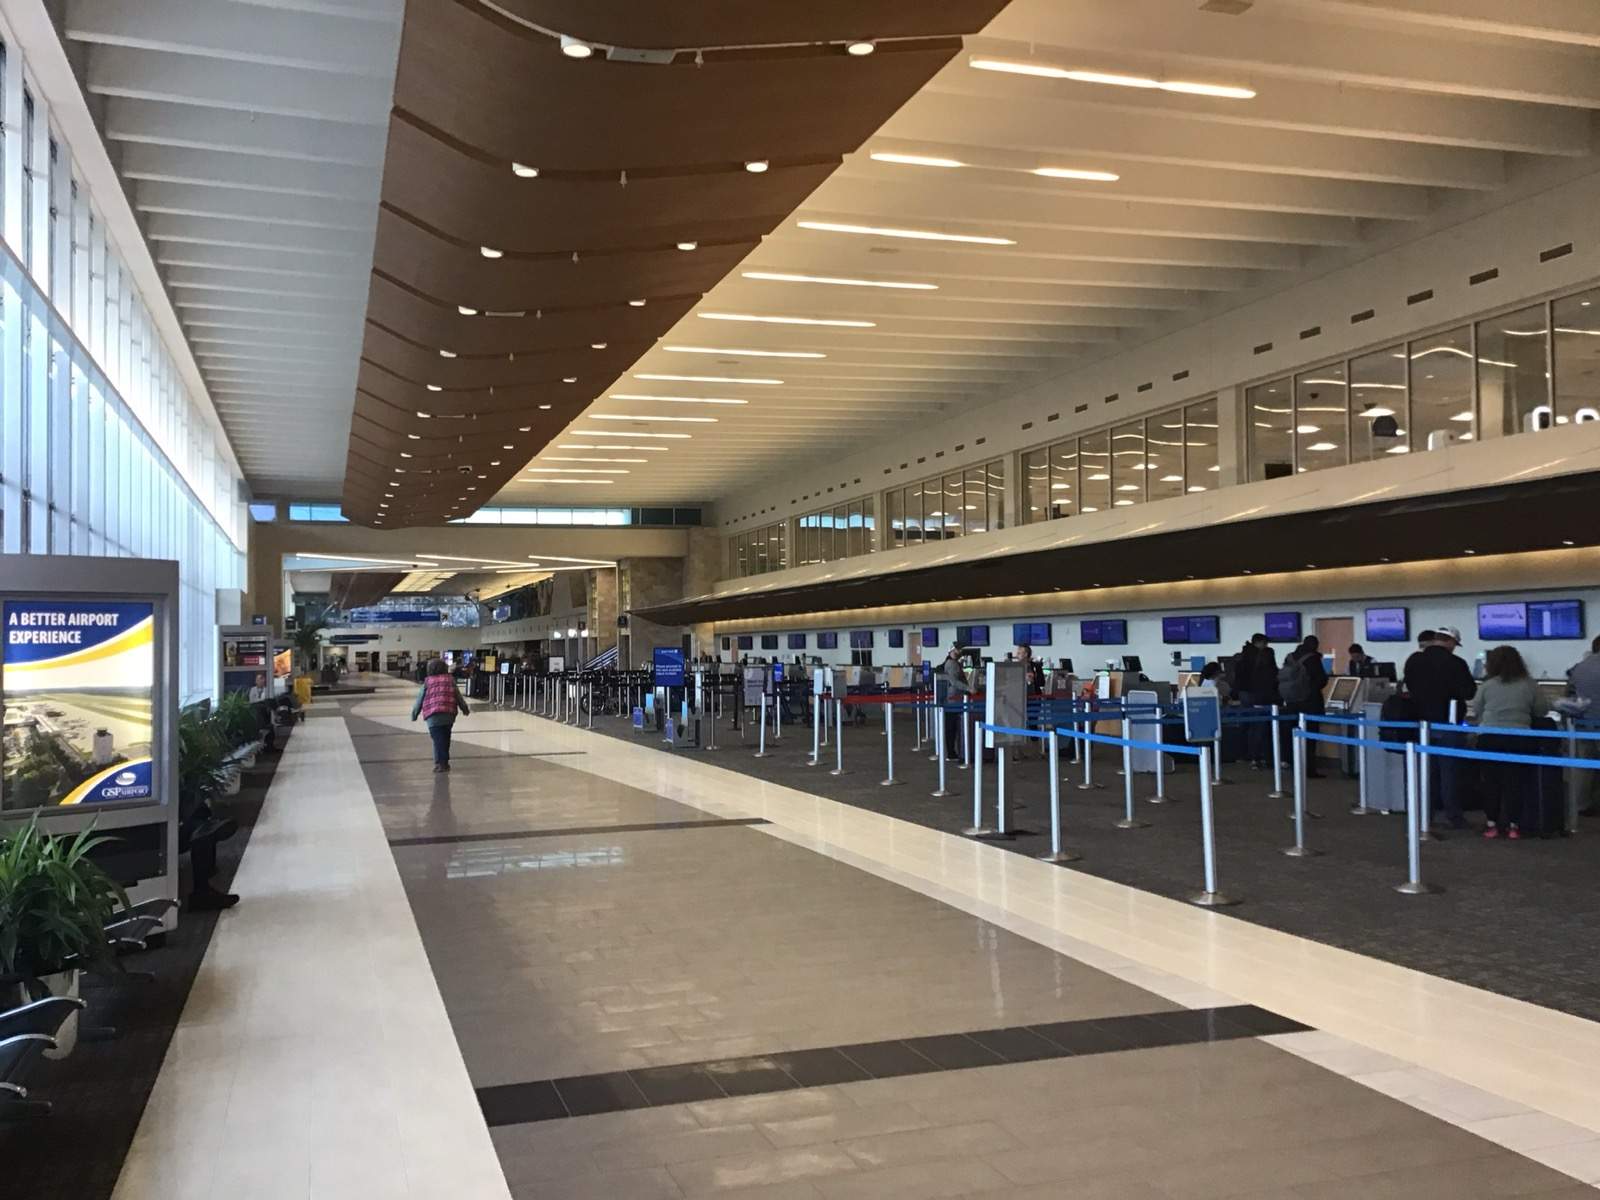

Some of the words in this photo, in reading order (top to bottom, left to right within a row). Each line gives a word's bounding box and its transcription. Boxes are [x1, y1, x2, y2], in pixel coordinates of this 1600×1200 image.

[9, 612, 18, 626] A
[21, 612, 66, 626] BETTER
[68, 613, 119, 626] AIRPORT
[9, 630, 82, 644] EXPERIENCE
[101, 786, 121, 798] GSP
